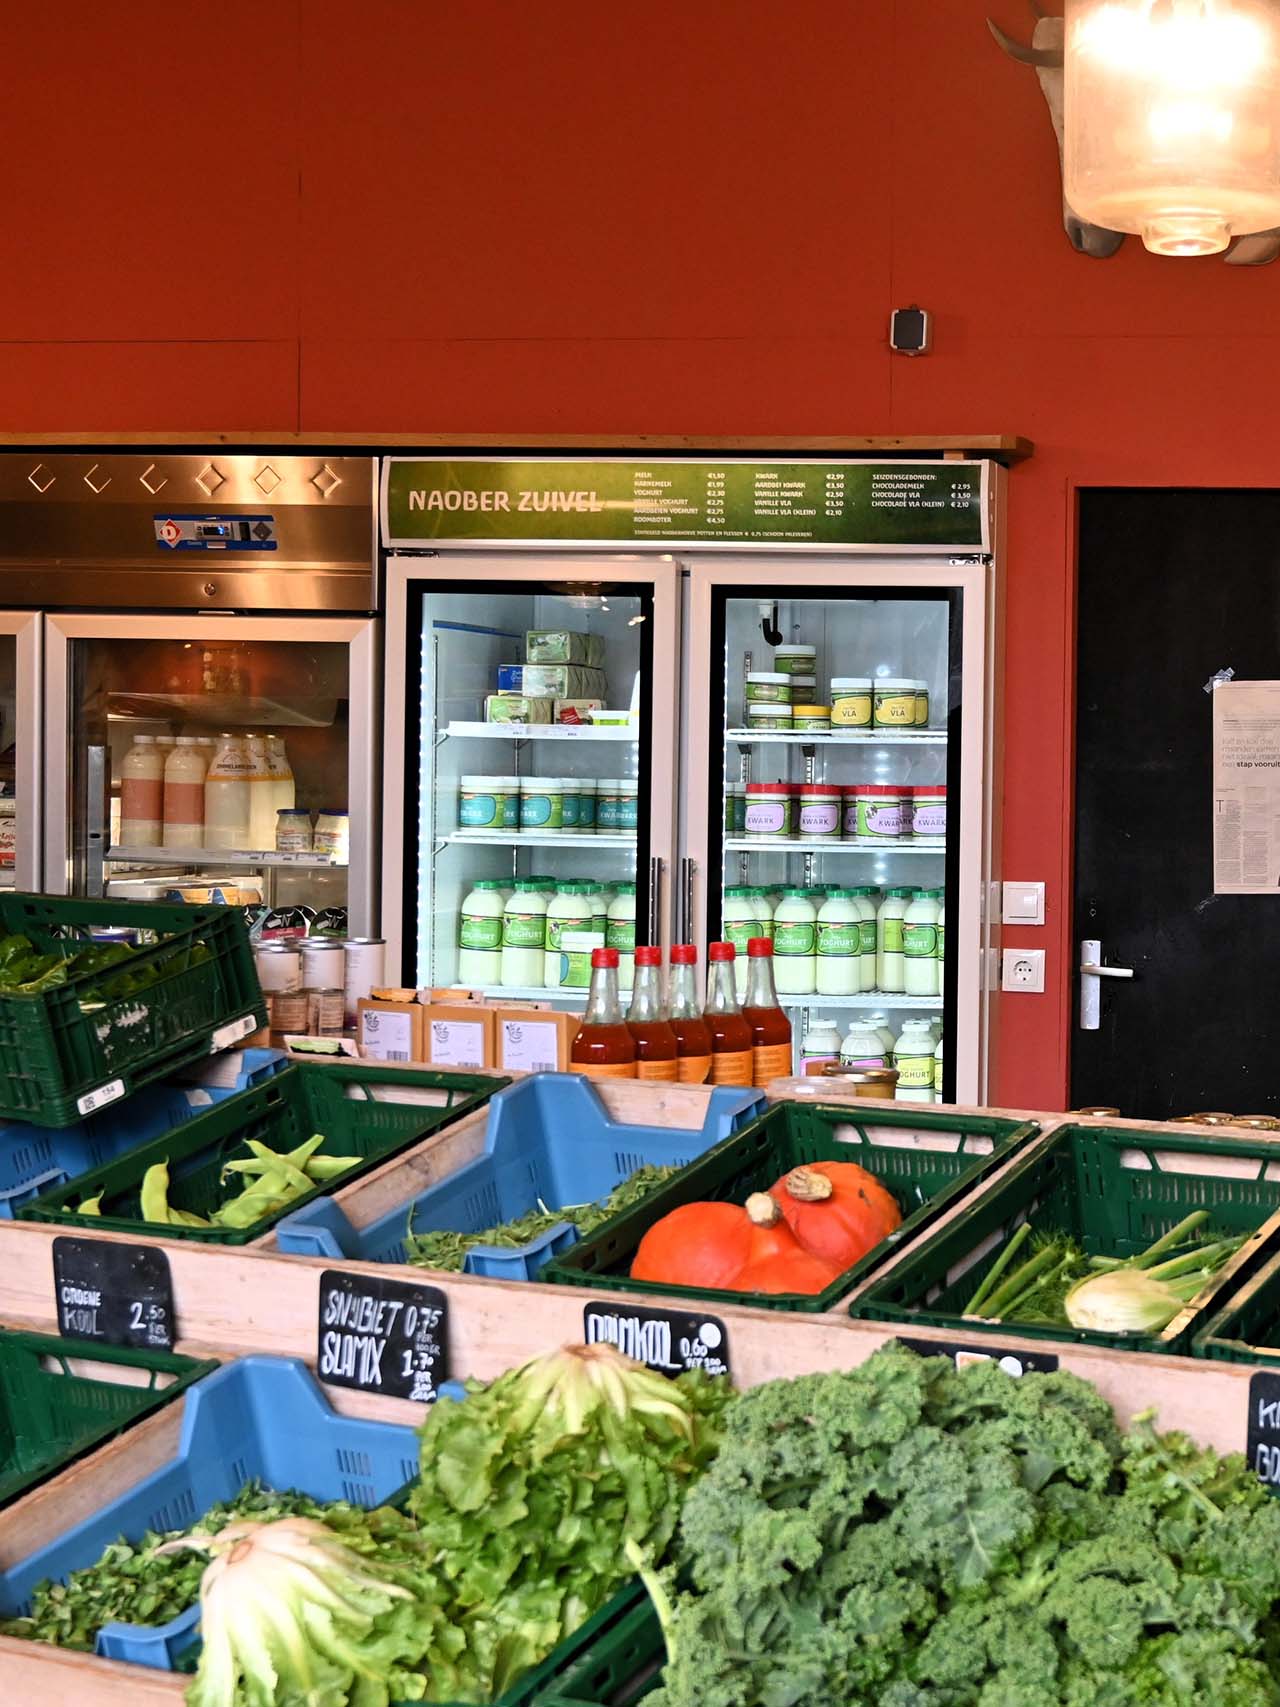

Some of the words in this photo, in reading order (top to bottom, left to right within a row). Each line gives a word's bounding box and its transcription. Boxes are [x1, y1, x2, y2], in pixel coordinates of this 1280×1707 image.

[409, 490, 510, 512] NAOBER
[518, 491, 602, 512] ZUIVEL
[899, 1071, 931, 1079] OGHURT
[64, 1306, 104, 1335] KOOL
[321, 1331, 386, 1385] SLAMIX
